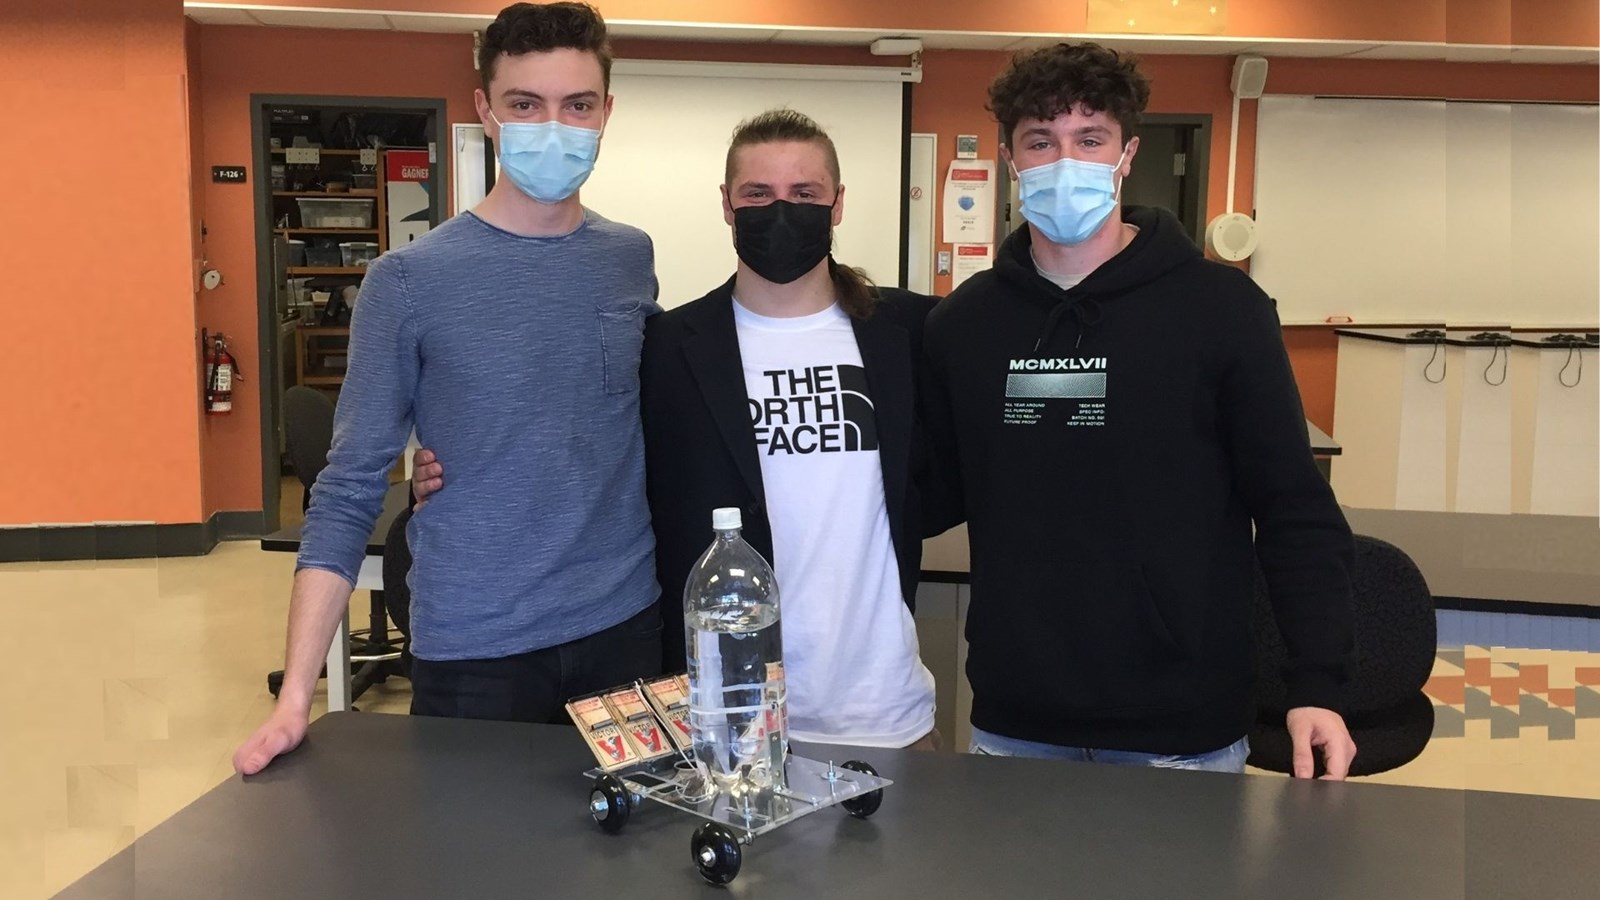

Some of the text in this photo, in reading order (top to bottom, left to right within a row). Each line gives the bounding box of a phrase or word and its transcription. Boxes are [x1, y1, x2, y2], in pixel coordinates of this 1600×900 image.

[219, 170, 239, 178] F-126
[1009, 357, 1107, 370] MCMXLVII
[763, 365, 836, 396] THE
[754, 423, 841, 456] FACE
